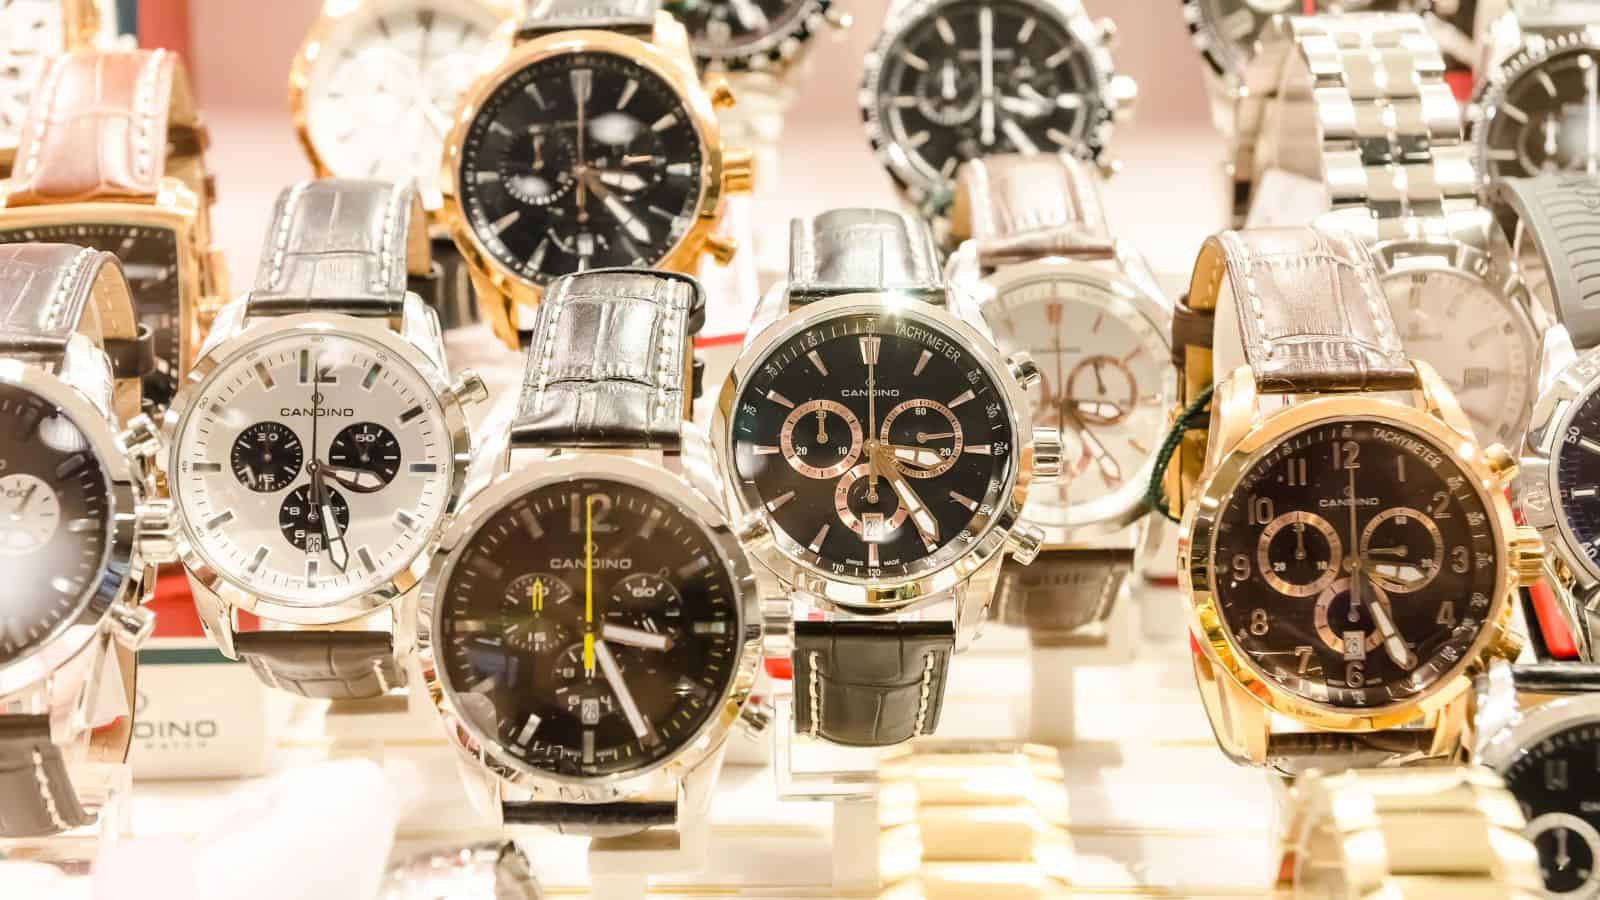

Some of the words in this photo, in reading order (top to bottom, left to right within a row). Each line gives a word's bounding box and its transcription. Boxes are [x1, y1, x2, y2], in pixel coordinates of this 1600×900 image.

[894, 321, 962, 364] TACHYMETER
[841, 389, 900, 397] CANDINO
[279, 407, 355, 417] CANDINO
[257, 433, 279, 442] 30
[795, 445, 808, 456] 20
[838, 445, 848, 455] 10
[1372, 428, 1443, 469] TACHYMETER
[939, 447, 951, 457] 20
[1333, 441, 1361, 470] 12
[1288, 458, 1308, 486] 11
[1398, 455, 1406, 482] 1
[289, 506, 300, 516] 8
[570, 493, 611, 532] 12
[1248, 494, 1274, 525] 10
[1433, 492, 1452, 518] 2
[307, 537, 321, 553] 26
[550, 558, 633, 569] CANDINO
[867, 567, 881, 577] 120
[1232, 553, 1251, 581] 9
[1451, 545, 1470, 574] 3
[1250, 608, 1269, 636] 8
[1436, 600, 1457, 629] 4
[1294, 645, 1313, 673] 7
[1346, 660, 1366, 688] 6
